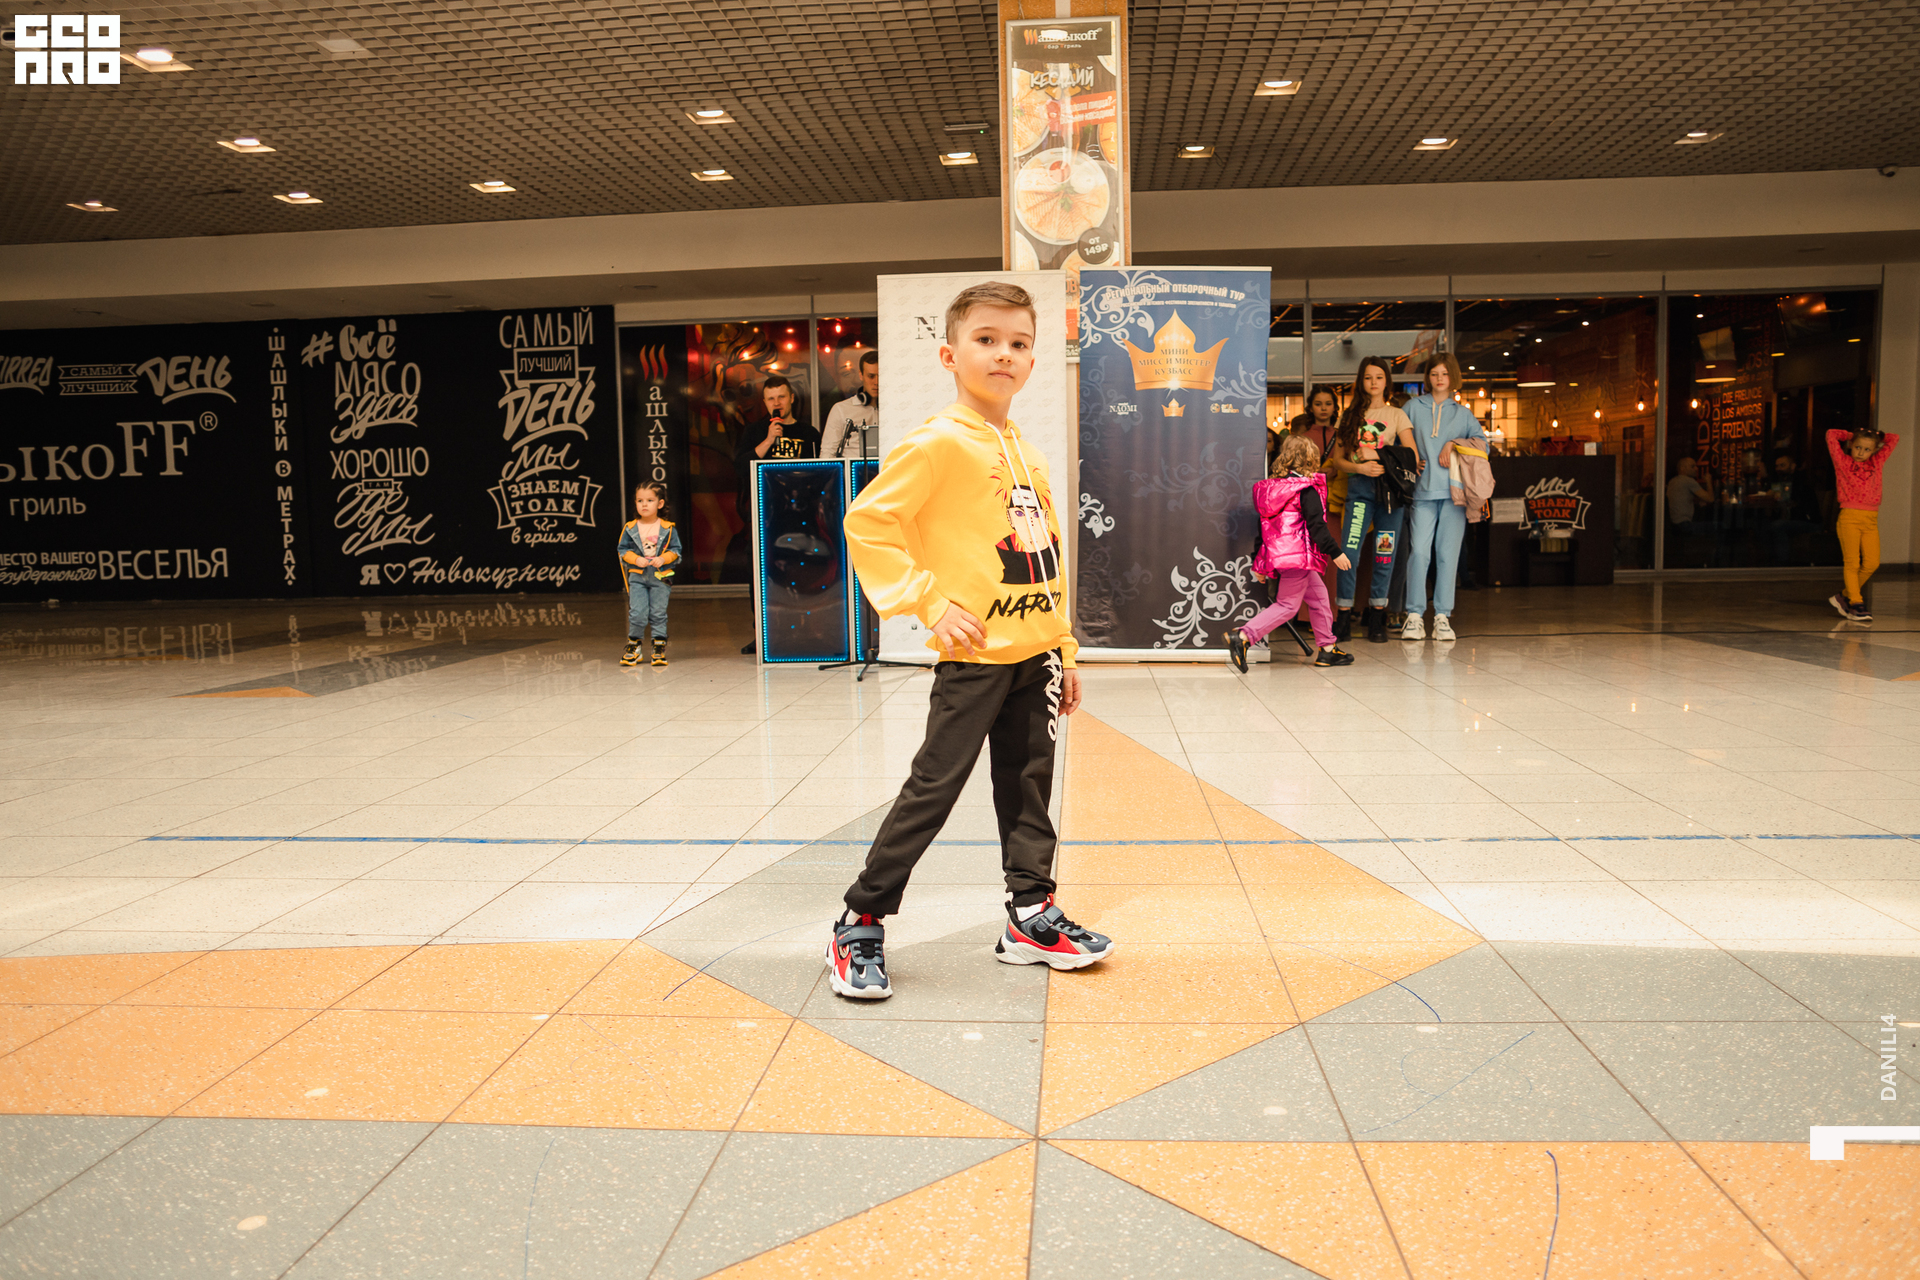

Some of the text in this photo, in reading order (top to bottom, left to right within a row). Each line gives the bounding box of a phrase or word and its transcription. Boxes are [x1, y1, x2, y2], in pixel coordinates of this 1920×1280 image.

[1105, 283, 1245, 301] РЕГИОНАЛЬНЫЙ ОТБОРОЧНЫЙ ТУР
[500, 307, 594, 349] САМЫЙ
[1160, 348, 1189, 356] МИНИ
[70, 363, 123, 377] САМЫЙ
[519, 354, 572, 373] ЛУЧШИЙ
[1138, 358, 1164, 366] МИСС
[1174, 358, 1211, 367] МИСТЕР
[137, 355, 233, 397] ДЕНЬ
[335, 361, 421, 399] МЯСО
[1154, 368, 1194, 376] КУЗБАСС
[66, 380, 131, 393] ЛУЧШИЙ
[268, 335, 289, 452] ШАШЛЫКИ
[498, 380, 596, 441] ДЕНЬ
[1109, 404, 1137, 413] NAOMI
[1722, 402, 1762, 419] LOS AMIGOS
[1721, 418, 1762, 439] FRIENDS
[330, 446, 429, 479] ХОРОШО
[368, 481, 390, 489] ТАМ
[508, 480, 580, 498] ЗНАЕМ
[9, 497, 87, 521] гриль
[511, 498, 576, 514] ТОЛК
[1529, 498, 1577, 511] ЗНАЕМ
[1534, 508, 1572, 519] ТОЛК
[277, 486, 296, 580] МЕТРАХ
[1346, 501, 1367, 551] POPVIOLET
[524, 531, 578, 548] гриле
[41, 551, 96, 565] ВАШЕГО
[98, 547, 229, 581] ВЕСЕЛЬЯ
[1375, 555, 1392, 565] OPEN
[360, 556, 581, 588] Я Новокузнецк
